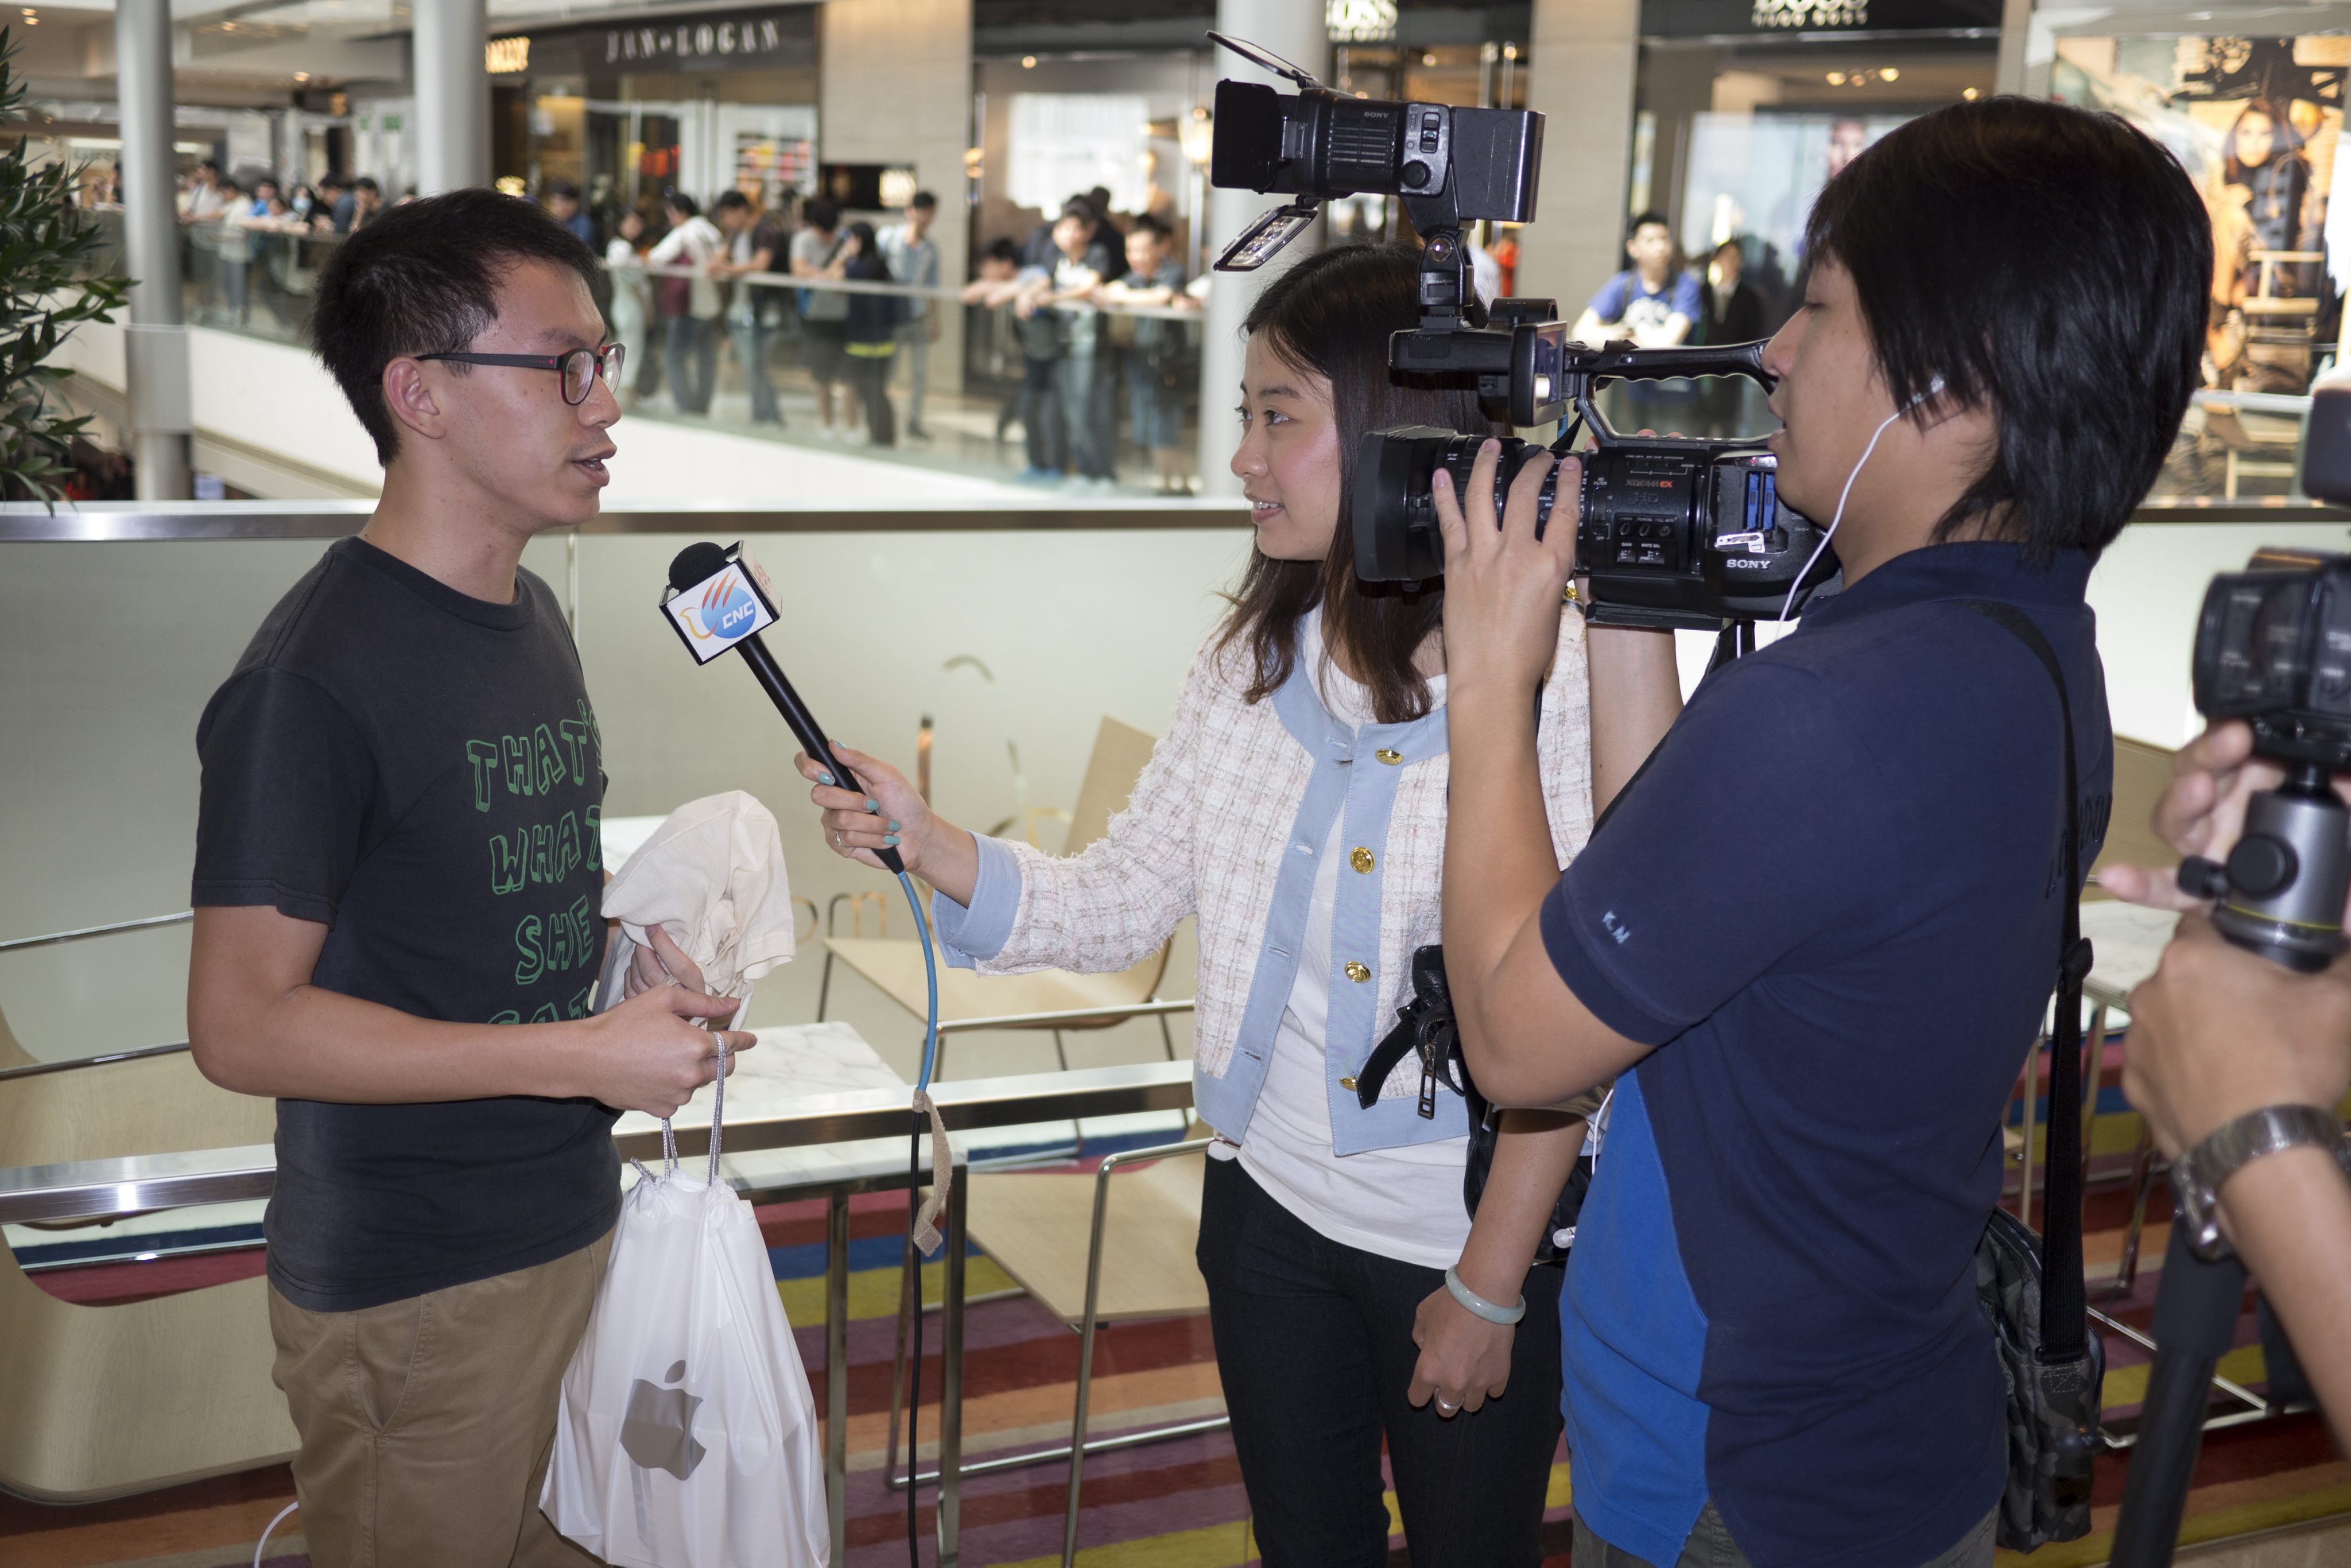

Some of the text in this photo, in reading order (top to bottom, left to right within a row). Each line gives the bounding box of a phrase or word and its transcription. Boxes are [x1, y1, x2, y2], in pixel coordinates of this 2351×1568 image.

[1727, 559, 1771, 569] SONY
[722, 601, 754, 630] CNC
[515, 894, 594, 985] SHE
